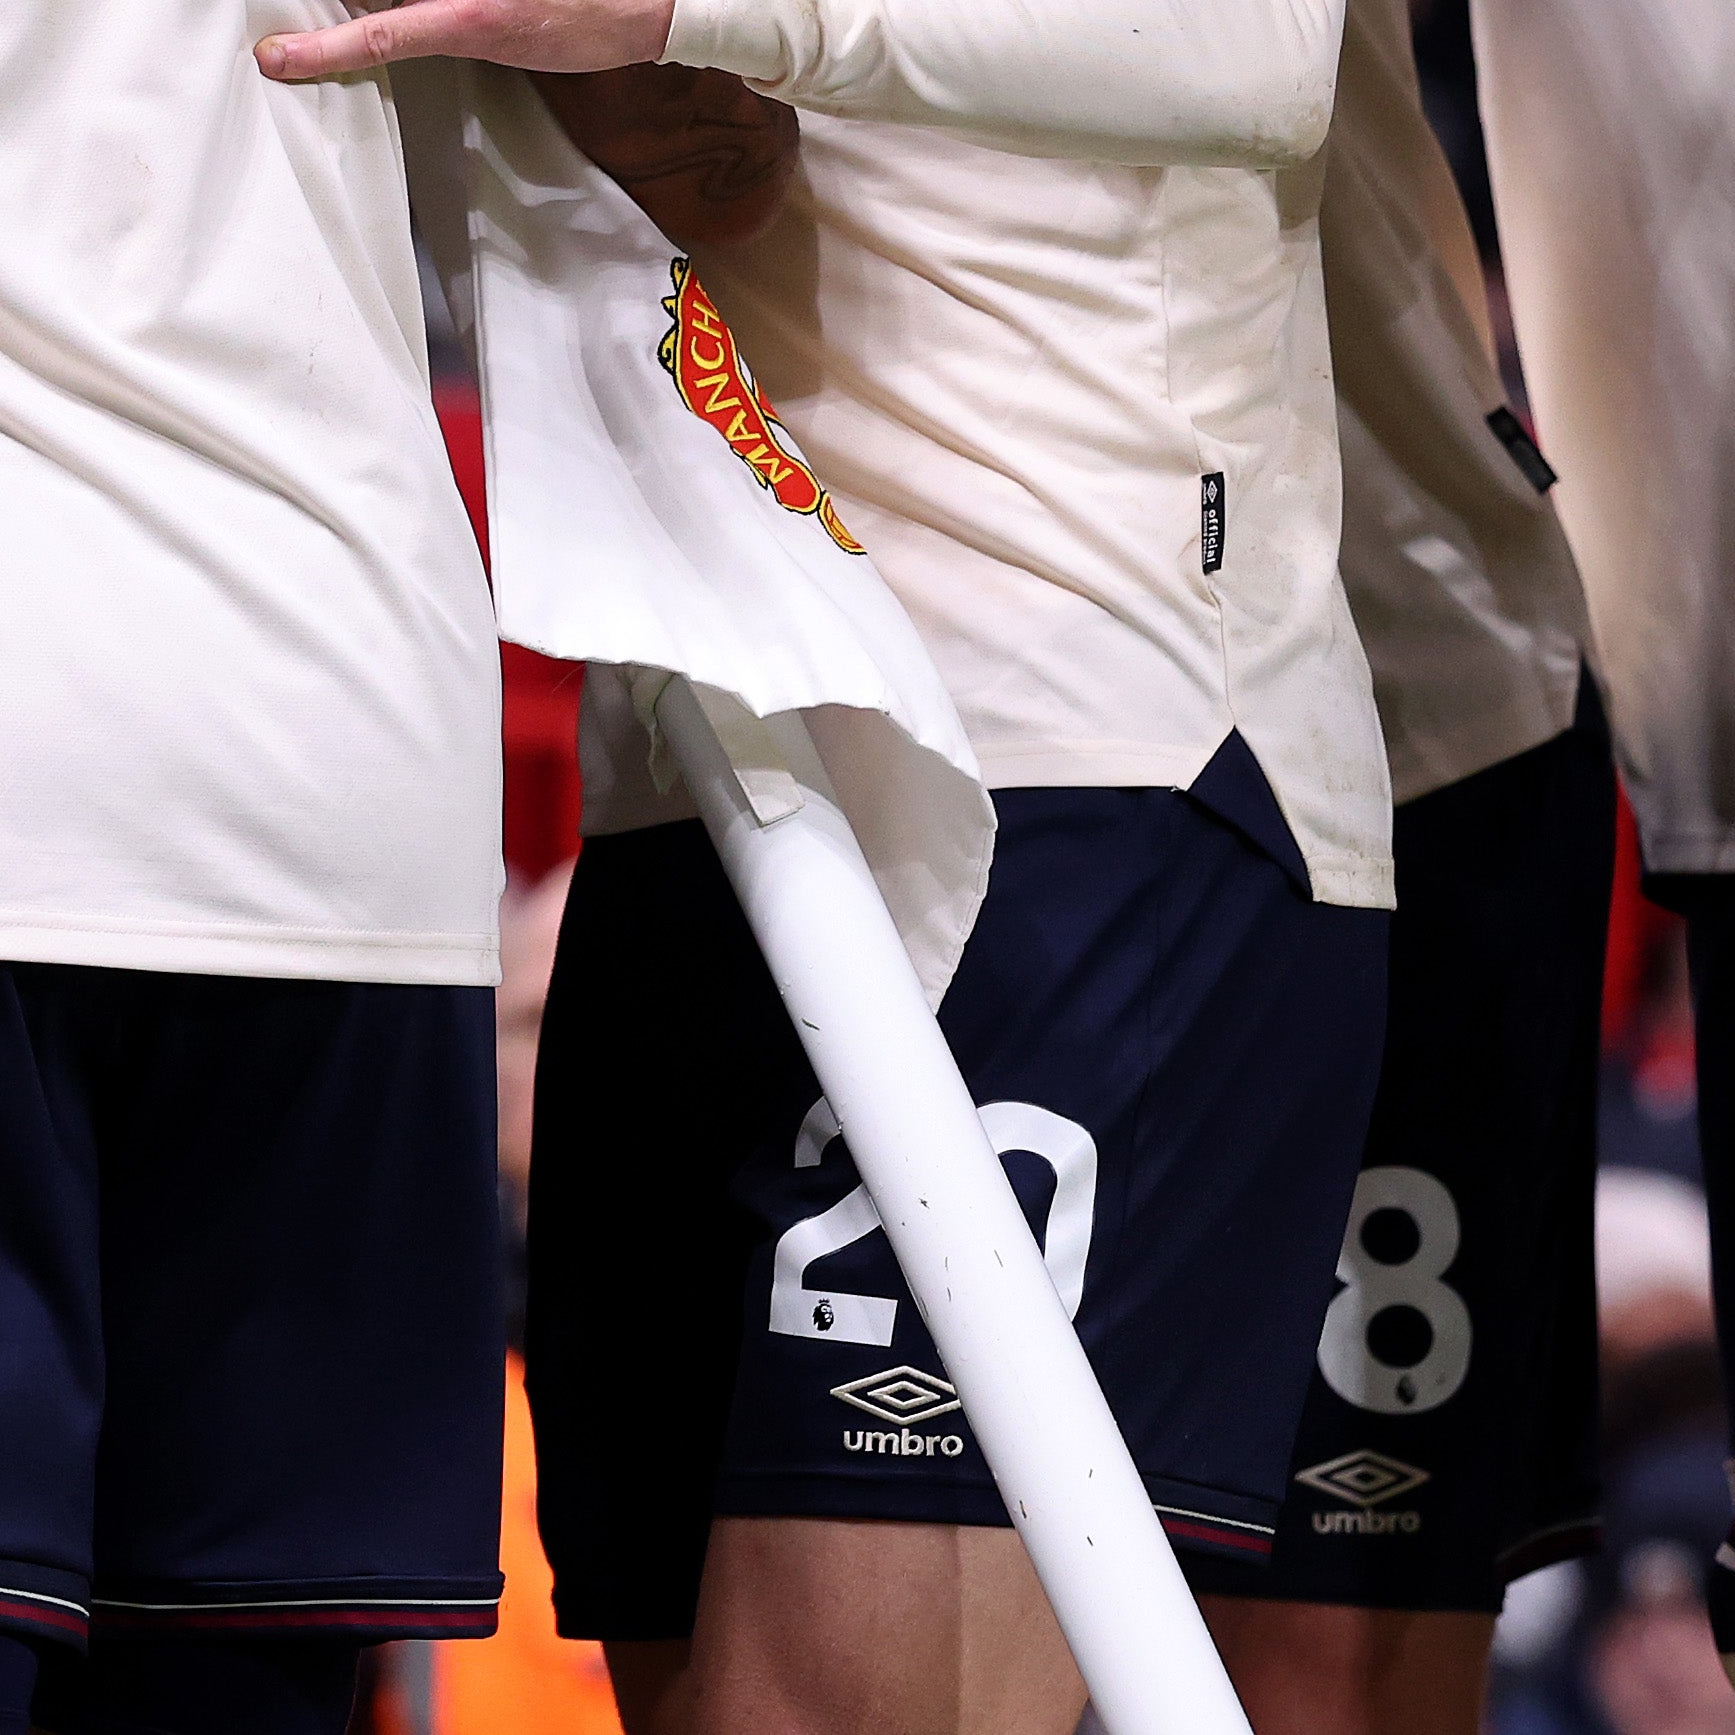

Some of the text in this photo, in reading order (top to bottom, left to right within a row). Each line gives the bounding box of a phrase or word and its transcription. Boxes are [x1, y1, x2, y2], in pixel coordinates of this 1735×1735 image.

[690, 280, 793, 485] MANCH
[1206, 508, 1219, 563] official
[768, 1095, 1098, 1348] 20
[1317, 1165, 1473, 1415] 8
[842, 1427, 964, 1457] umbro
[1312, 1506, 1420, 1535] umbro
